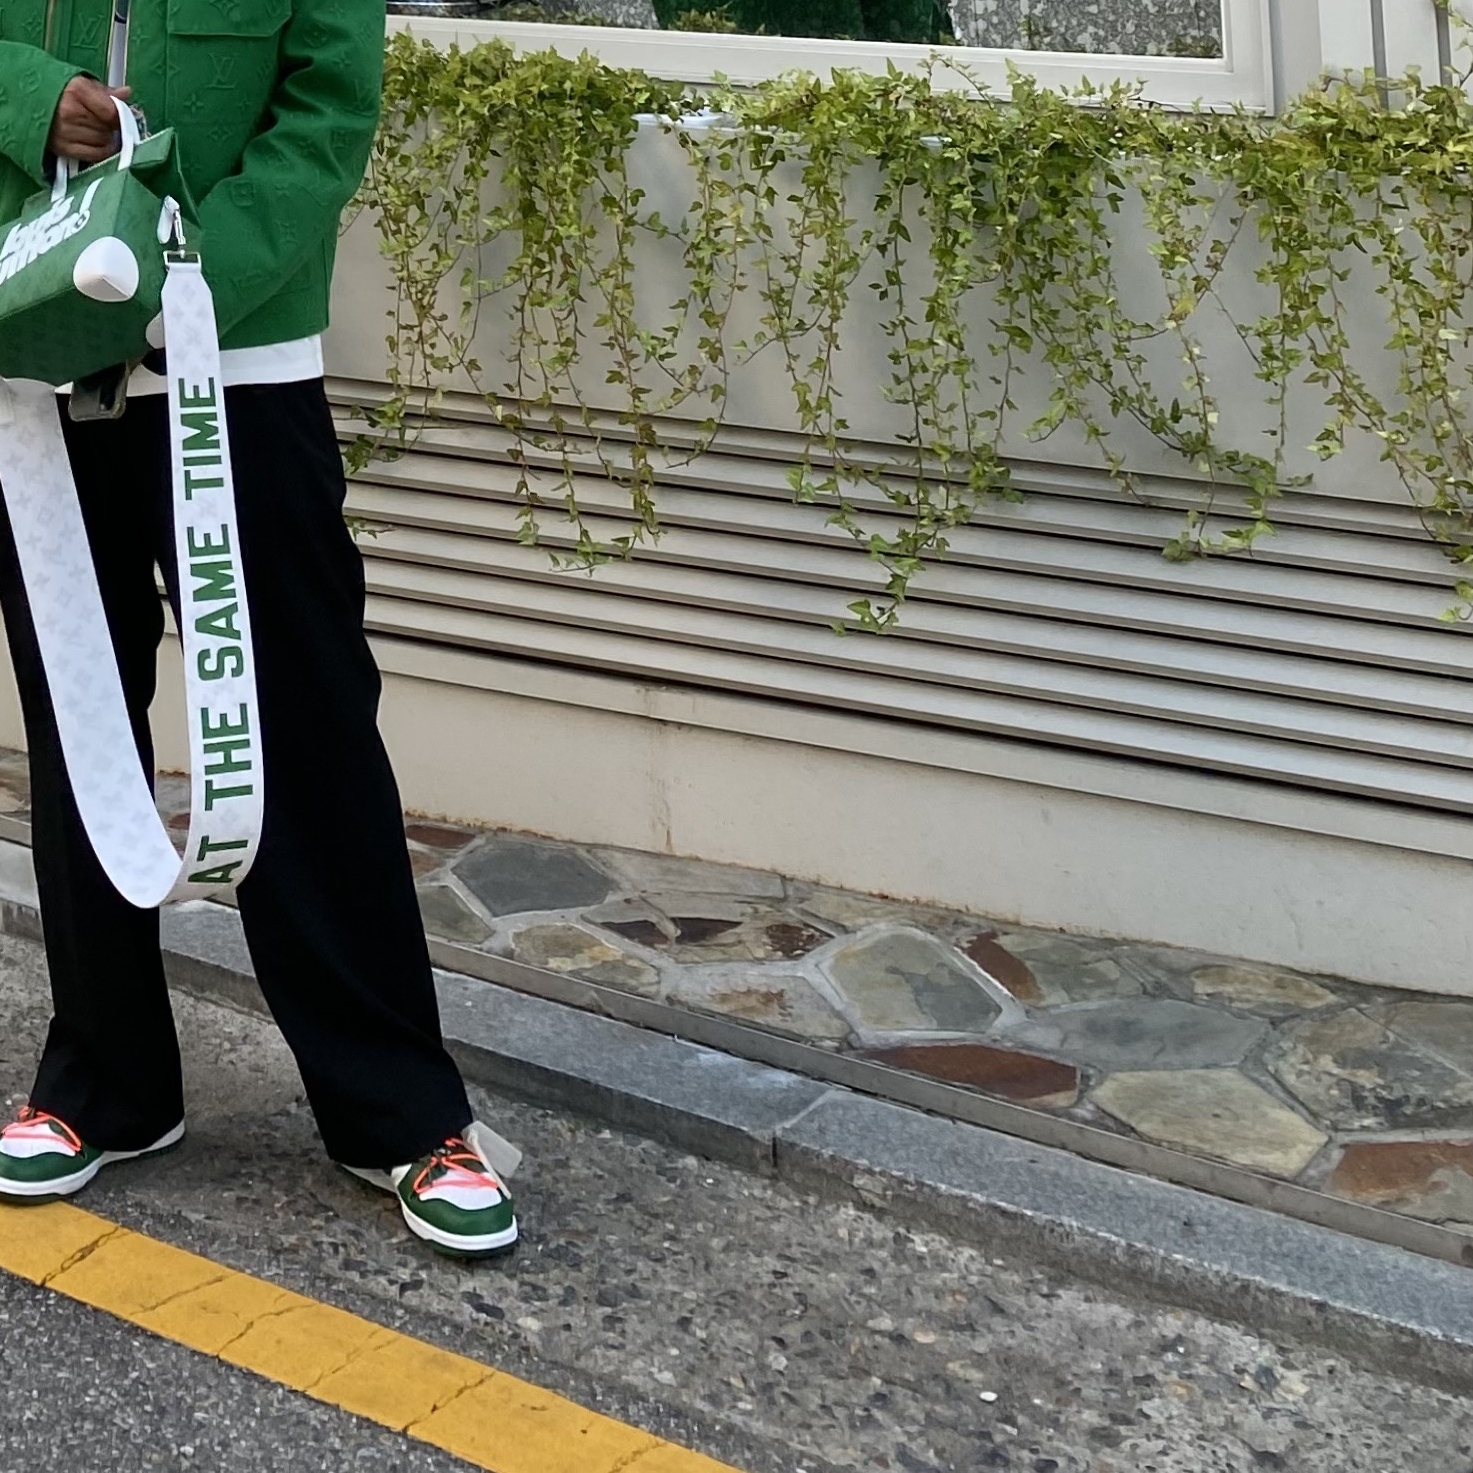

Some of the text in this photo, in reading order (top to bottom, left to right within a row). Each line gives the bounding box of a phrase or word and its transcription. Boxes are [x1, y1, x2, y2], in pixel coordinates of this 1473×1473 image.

[178, 377, 254, 884] AT THE SAME TIME
